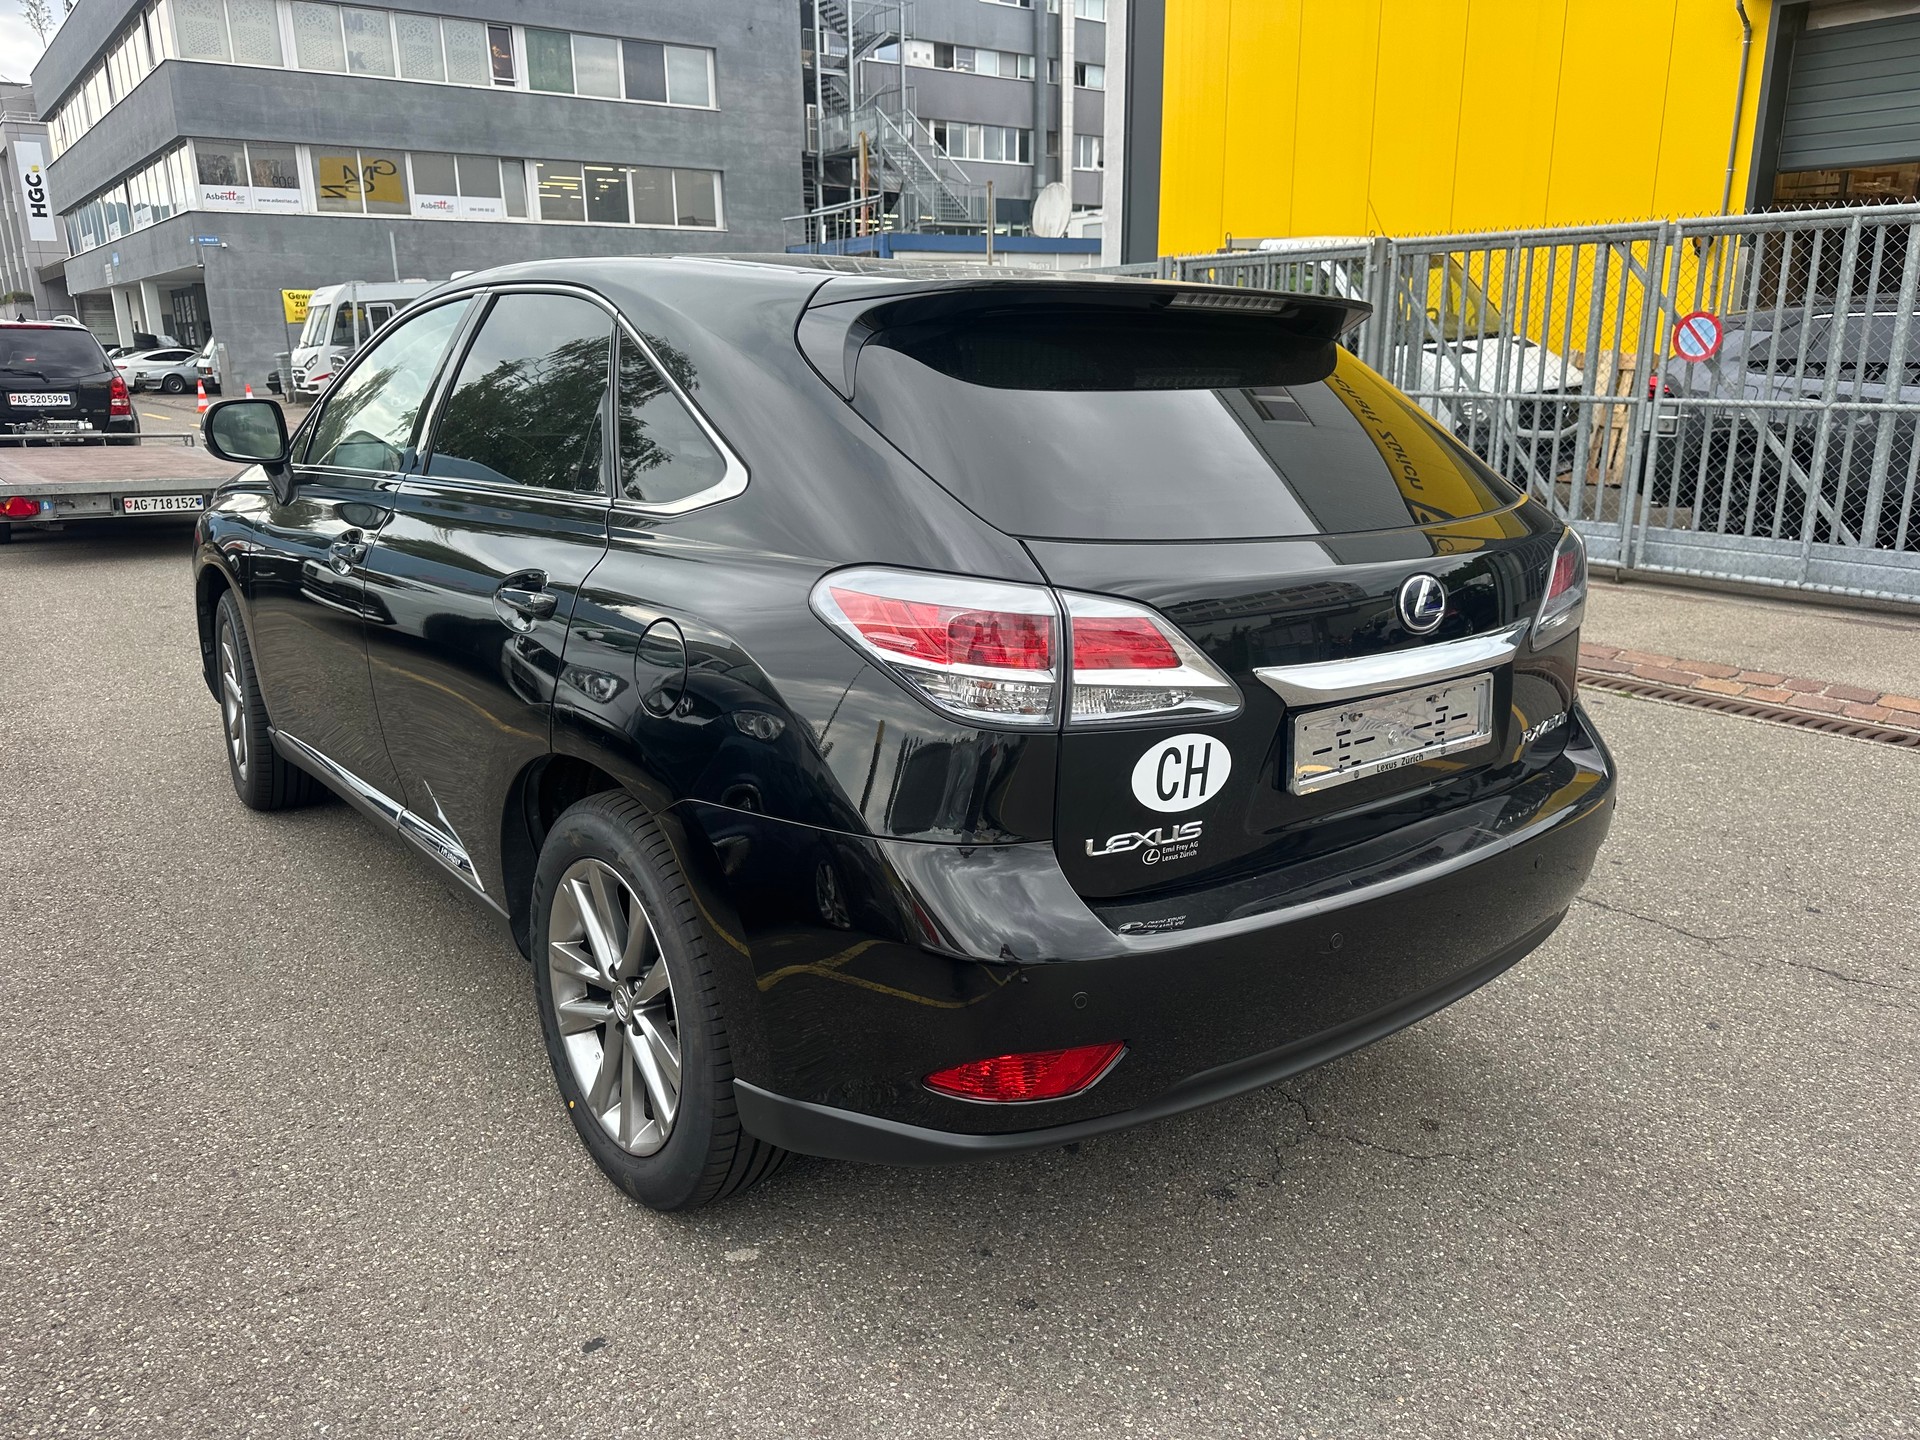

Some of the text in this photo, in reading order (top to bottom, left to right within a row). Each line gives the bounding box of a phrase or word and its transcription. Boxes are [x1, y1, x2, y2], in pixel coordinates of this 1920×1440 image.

[1156, 742, 1212, 802] CH
[1376, 752, 1424, 773] Lexus Zürich
[1085, 820, 1203, 857] LEXUS
[1162, 845, 1176, 854] Emil
[1189, 840, 1199, 849] AG
[1162, 849, 1198, 862] Lexus Zürich
